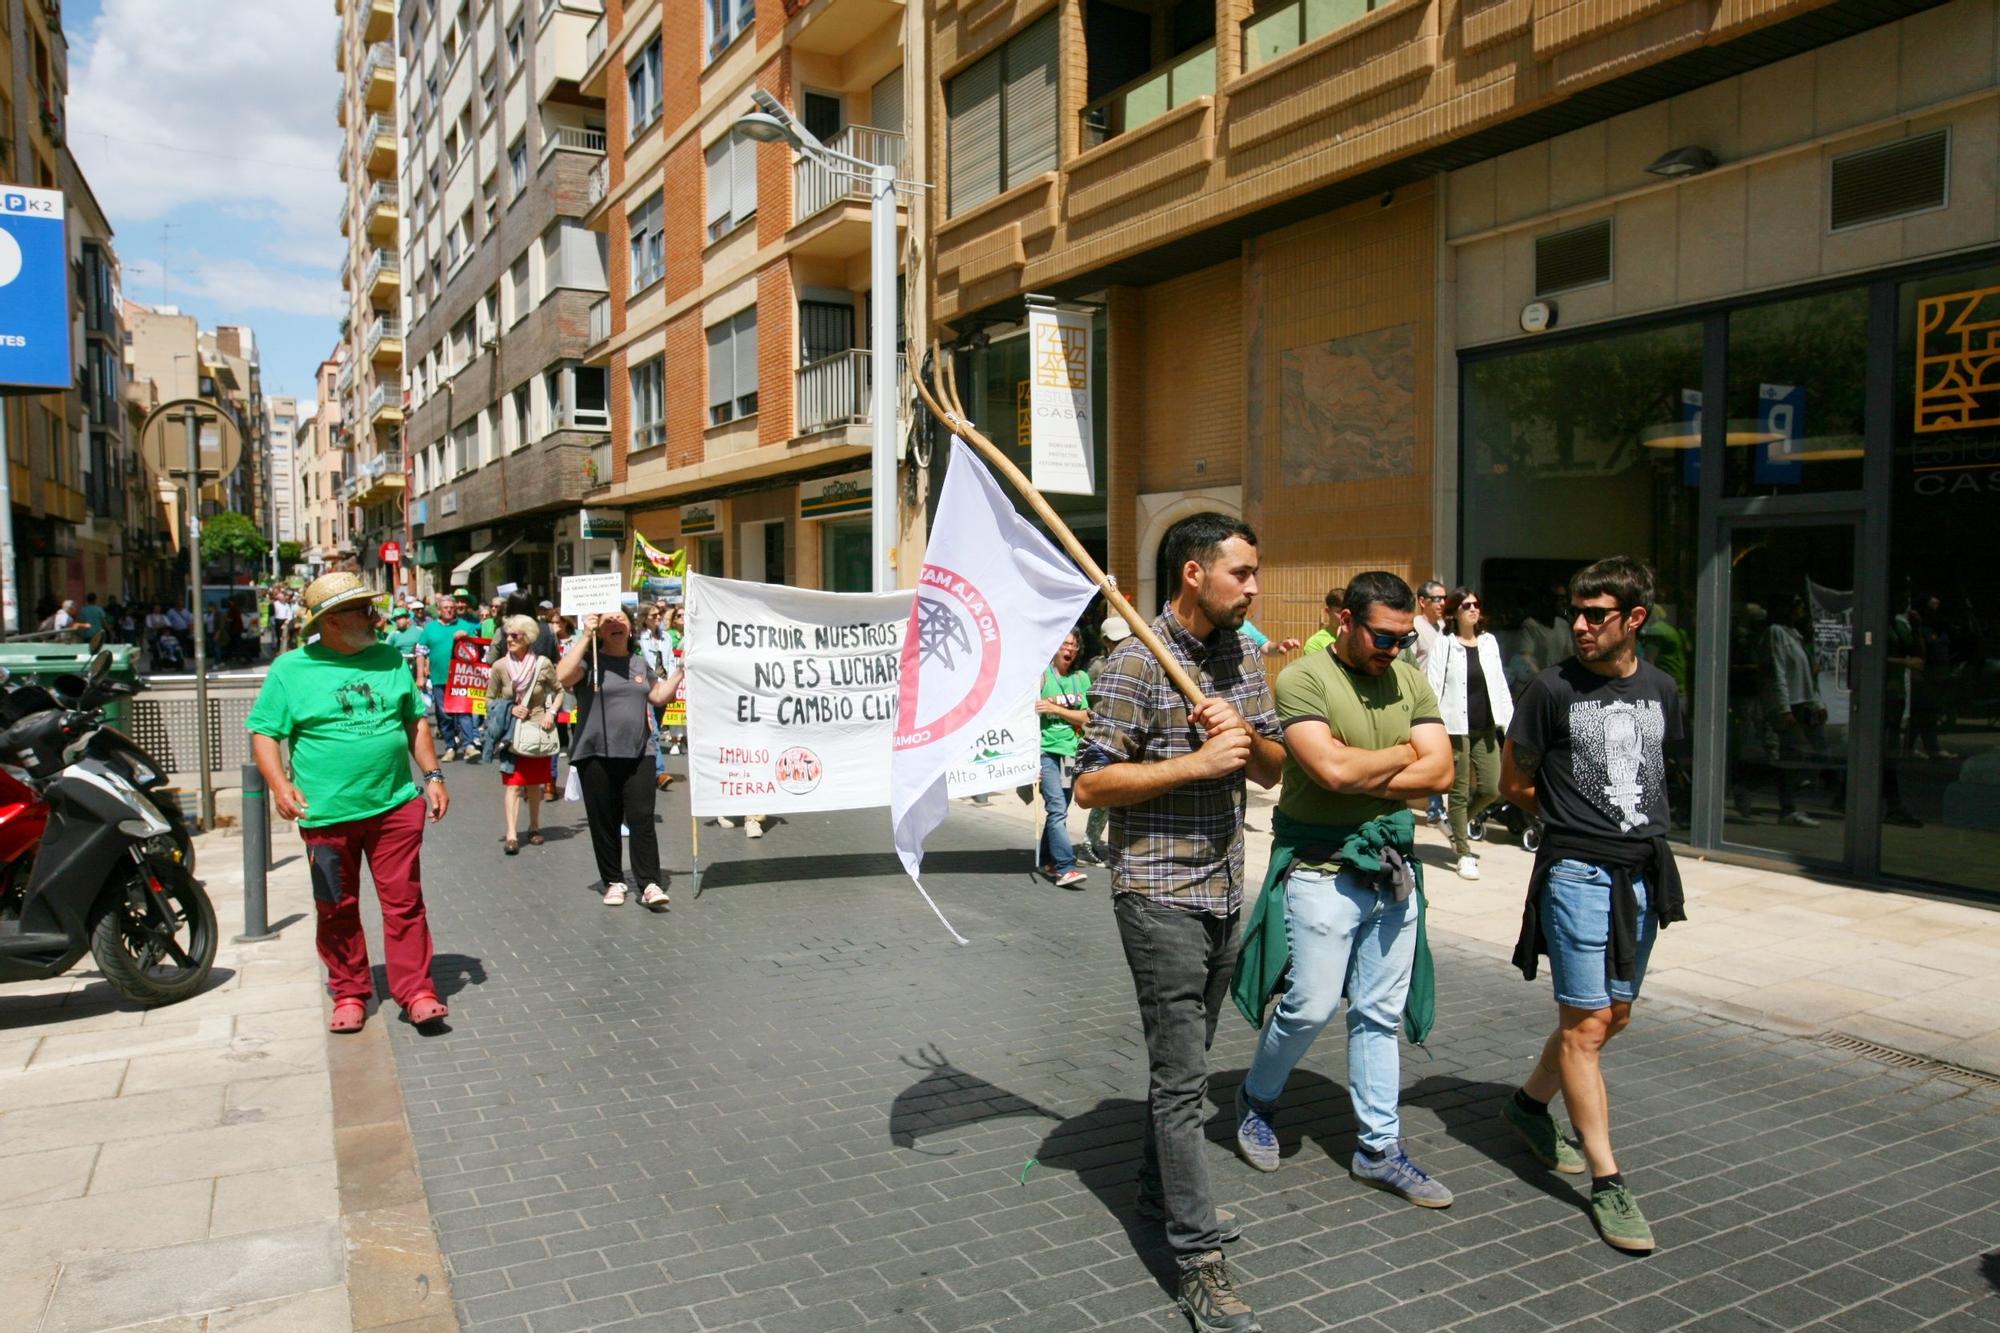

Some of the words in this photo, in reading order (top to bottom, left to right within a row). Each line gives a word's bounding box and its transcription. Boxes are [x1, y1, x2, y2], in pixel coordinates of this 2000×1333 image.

[1037, 407, 1088, 420] CASA
[815, 622, 897, 649] NUESTROS
[755, 661, 785, 689] NO
[793, 658, 821, 688] ES
[829, 654, 897, 686] LUCHAR
[451, 687, 467, 697] NO
[737, 695, 761, 723] EL
[1570, 700, 1601, 712] TOURIST
[719, 747, 769, 764] IMPULSO
[947, 769, 977, 785] Alto
[720, 781, 776, 796] TIERRA
